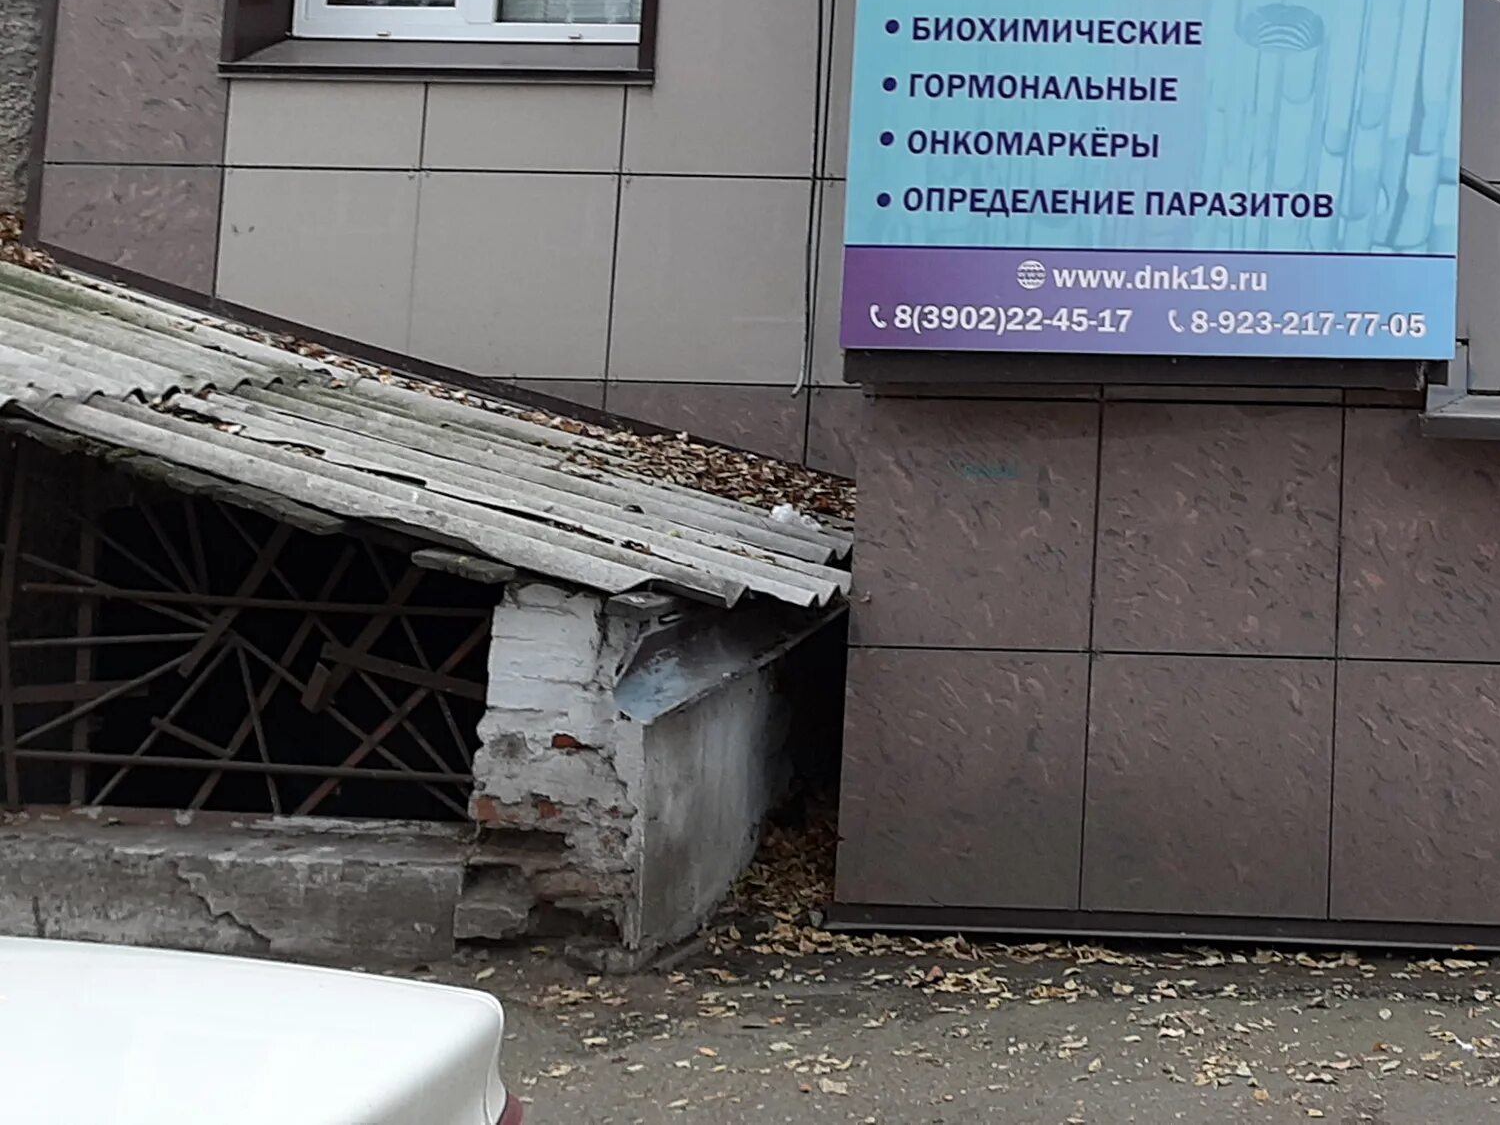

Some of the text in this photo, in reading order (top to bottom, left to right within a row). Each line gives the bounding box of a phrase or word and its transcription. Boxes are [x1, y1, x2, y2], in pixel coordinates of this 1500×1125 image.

[912, 18, 1203, 45] БИОХИМИЧЕСКИЕ
[909, 73, 1178, 102] ГОРМОНАЛЬНЫЕ
[907, 127, 1160, 158] ОНКОМАРКЁРЫ
[903, 188, 1334, 218] ОПРЕДЕЛЕНИЕ ПАРАЗИТОВ
[1053, 266, 1268, 294] www.dnk19.ru
[893, 305, 1427, 339] 8(3902)22-45-17 8-923-217-77-05
